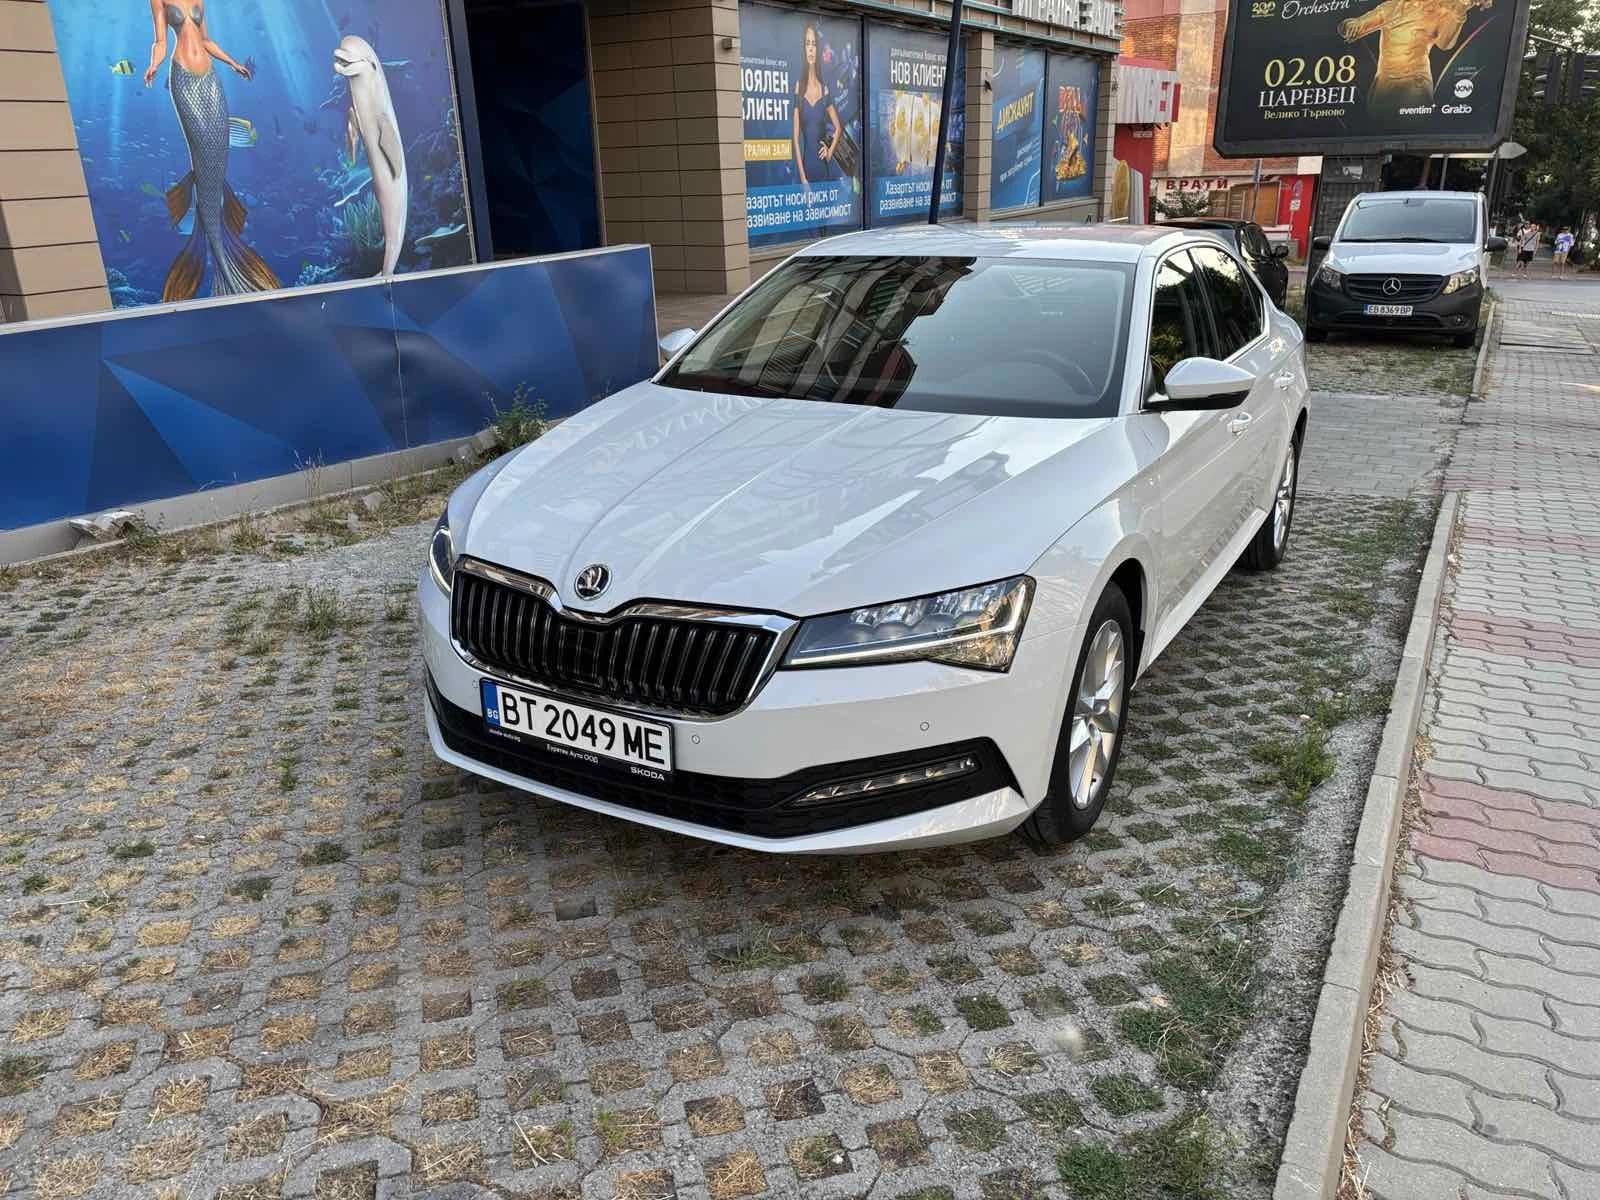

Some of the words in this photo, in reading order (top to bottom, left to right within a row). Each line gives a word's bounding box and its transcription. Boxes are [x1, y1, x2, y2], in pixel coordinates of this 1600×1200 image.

[890, 60, 911, 84] НОВ
[1264, 55, 1356, 87] 02.08
[1259, 86, 1356, 108] ЦАРЕВЕЦ
[742, 97, 790, 122] ЛИЕНТ
[1264, 109, 1300, 120] Велико
[1303, 107, 1345, 119] Търново
[1400, 105, 1432, 115] eventim
[1441, 104, 1473, 114] Grabo
[785, 192, 807, 206] носи
[808, 189, 828, 207] риск
[829, 189, 839, 201] от
[793, 209, 803, 222] на
[805, 203, 852, 221] зависимост
[487, 708, 499, 718] BG
[501, 692, 536, 731] BT
[543, 704, 616, 750] 2049
[623, 723, 665, 765] ME
